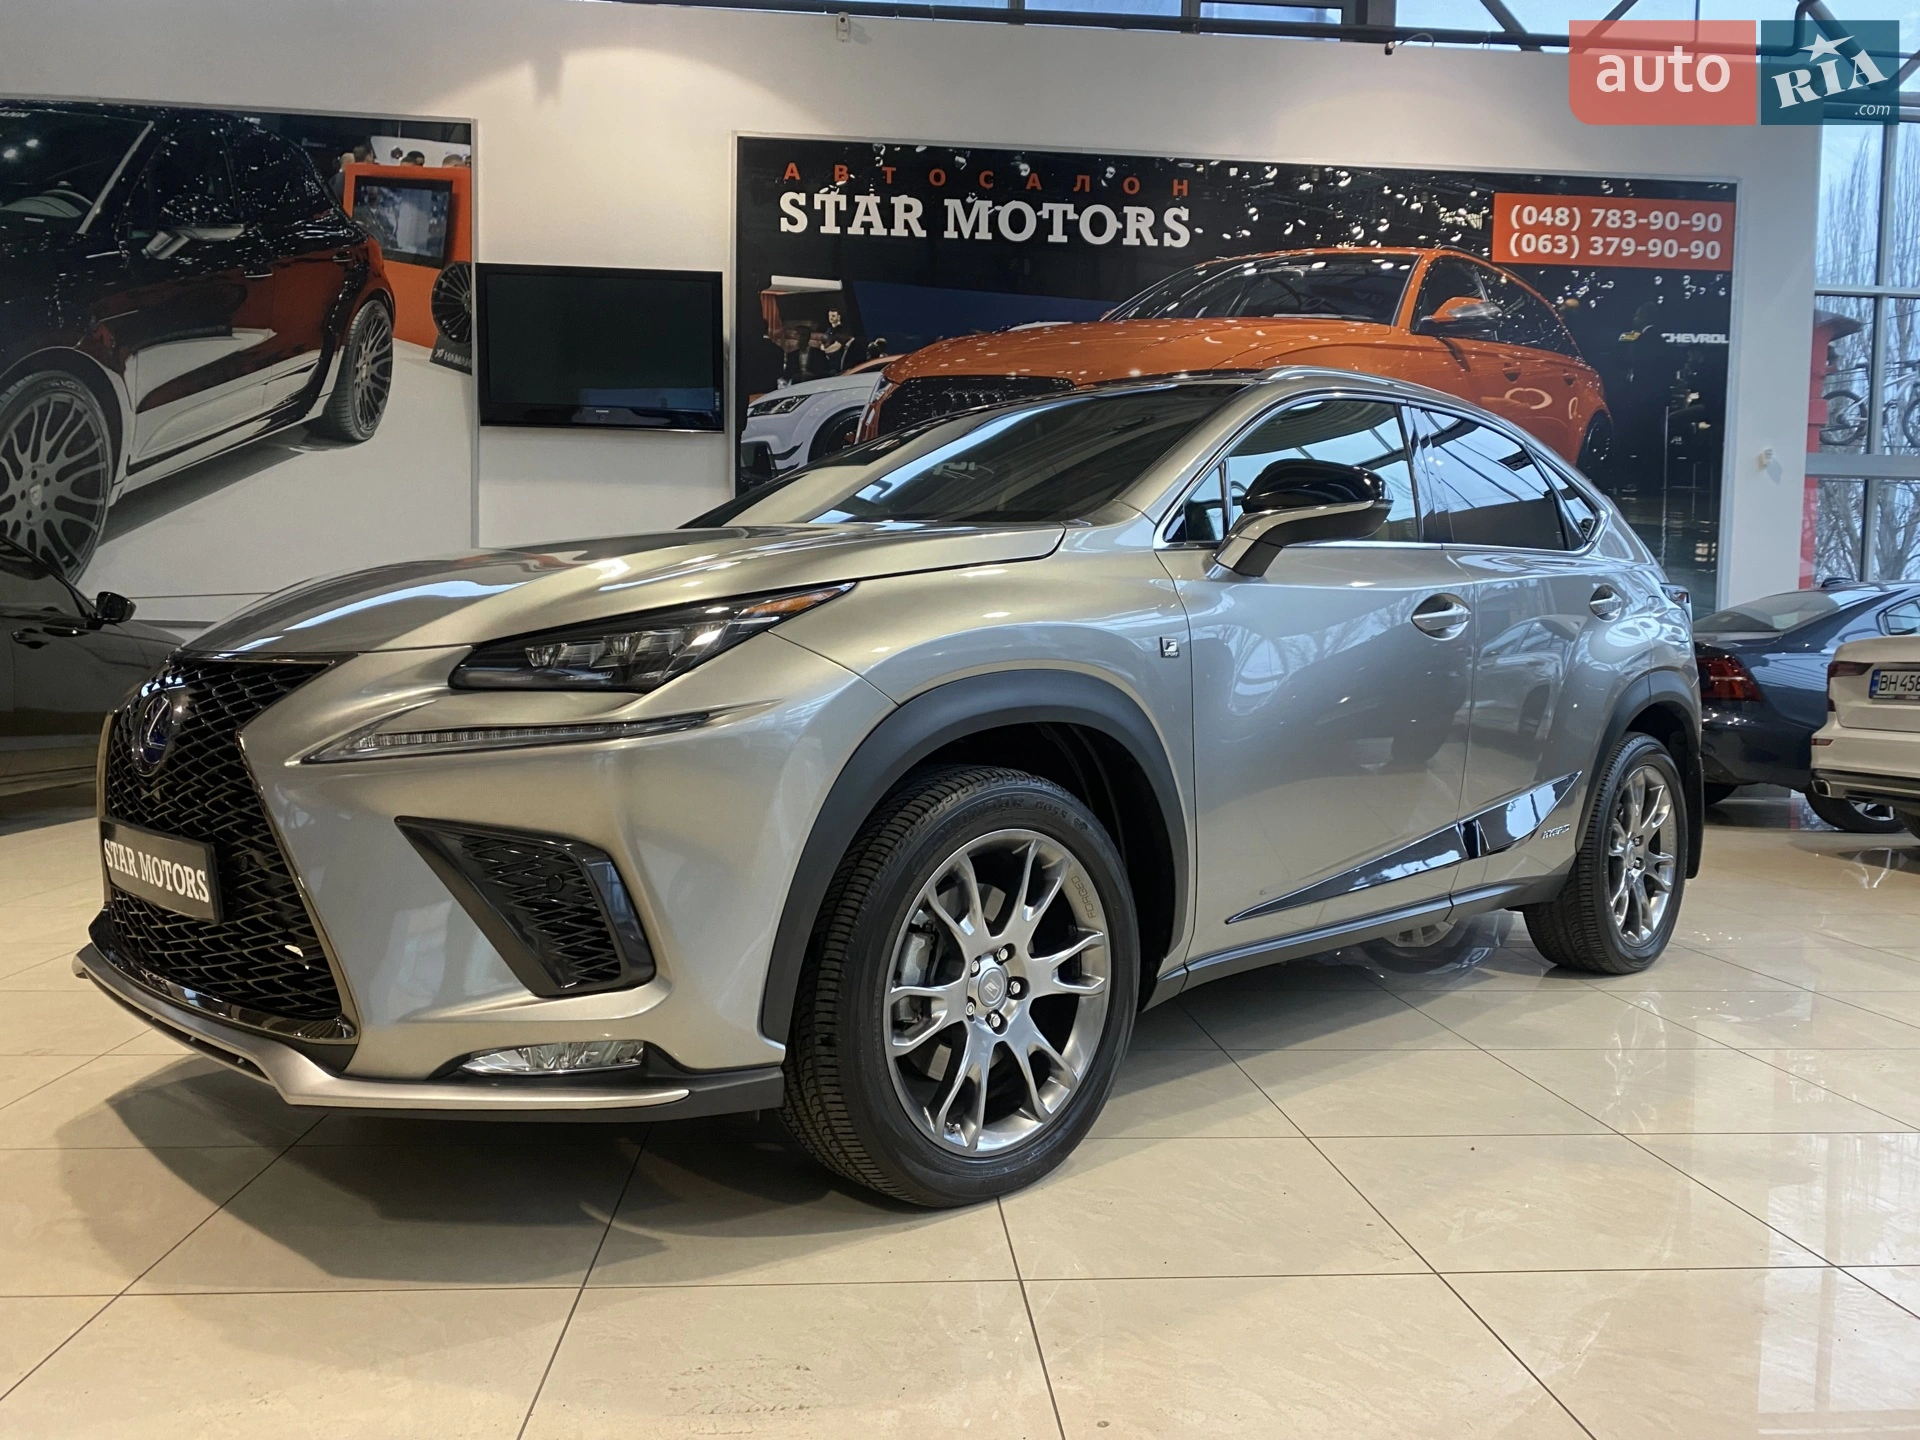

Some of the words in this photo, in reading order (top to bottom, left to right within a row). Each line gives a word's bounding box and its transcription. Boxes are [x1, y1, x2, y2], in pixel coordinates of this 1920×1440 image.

[783, 162, 1189, 197] АВТОСАЛОН
[780, 192, 926, 238] STAR
[943, 197, 1191, 248] MOTORS
[1510, 204, 1581, 232] (048)
[1591, 208, 1723, 233] 783-90-90
[1509, 232, 1580, 259] (063)
[1589, 236, 1721, 260] 379-90-90
[1879, 675, 1898, 691] BH
[104, 839, 138, 879] STAR
[138, 851, 209, 903] MOTORS
[1070, 875, 1097, 919] FORGED
